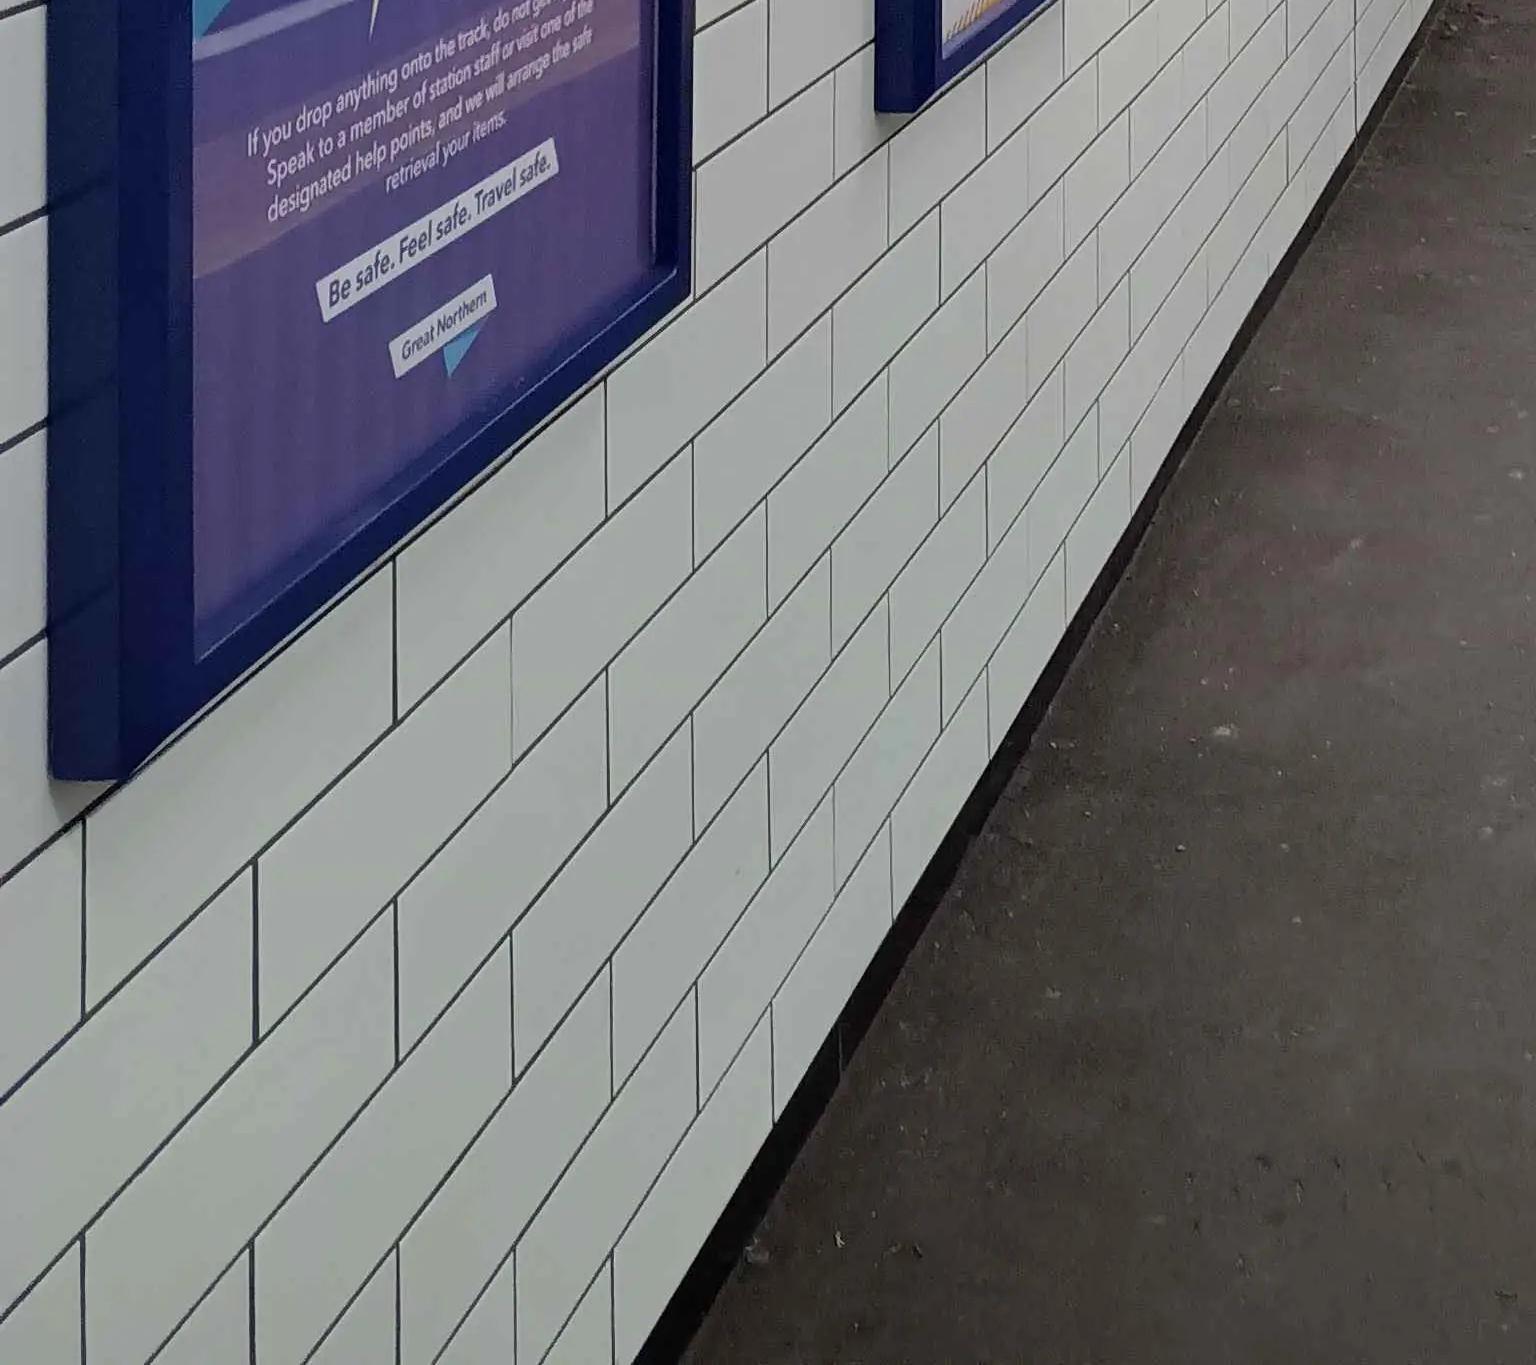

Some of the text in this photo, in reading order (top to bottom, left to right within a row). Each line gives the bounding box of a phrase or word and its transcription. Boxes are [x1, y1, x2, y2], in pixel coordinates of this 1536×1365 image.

[247, 127, 260, 157] If
[262, 120, 292, 158] you
[295, 104, 332, 128] drop
[335, 68, 398, 113] anything
[400, 51, 433, 81] onto
[434, 37, 456, 63] the
[457, 18, 491, 51] track,
[493, 6, 509, 33] do
[267, 140, 315, 188] Speak
[318, 136, 334, 159] to
[336, 130, 346, 149] a
[350, 98, 410, 142] member
[412, 78, 428, 110] of
[428, 63, 472, 101] station
[473, 40, 500, 76] staff
[502, 40, 515, 60] or
[515, 23, 540, 52] visit
[540, 15, 562, 39] one
[563, 0, 577, 28] of
[267, 24, 593, 223] designated help points, and we will arrange the safe
[385, 109, 508, 194] retrieval your items.
[328, 150, 552, 308] Be safe. Feel safe. Travel safe.
[401, 290, 488, 361] Great Northern
